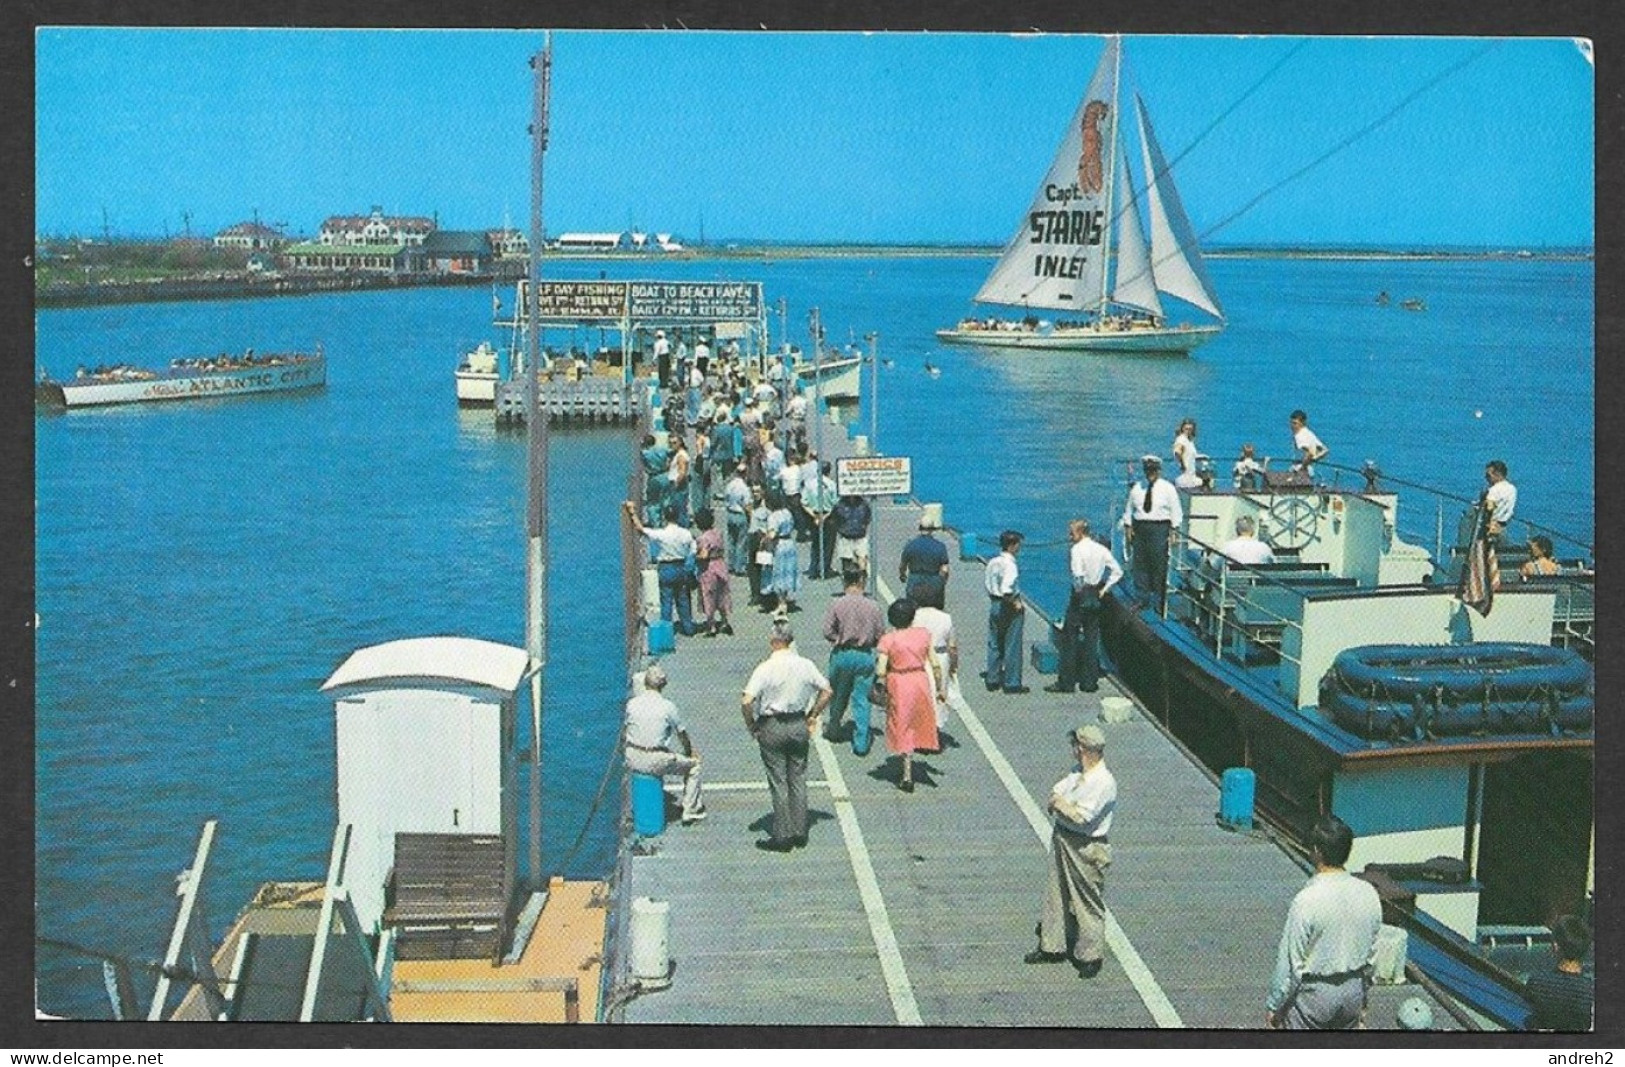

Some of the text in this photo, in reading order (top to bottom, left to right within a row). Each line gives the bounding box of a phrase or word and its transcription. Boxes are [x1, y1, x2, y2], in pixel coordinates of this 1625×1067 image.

[1034, 254, 1087, 280] INLET
[554, 284, 575, 295] DAY
[577, 284, 625, 295] FISHING
[631, 283, 753, 298] BOAT TO BEACH HAVEN
[631, 304, 659, 315] DAILY
[189, 373, 272, 393] ATLANTIC
[280, 370, 310, 384] CITY
[845, 459, 903, 471] NOTICE
